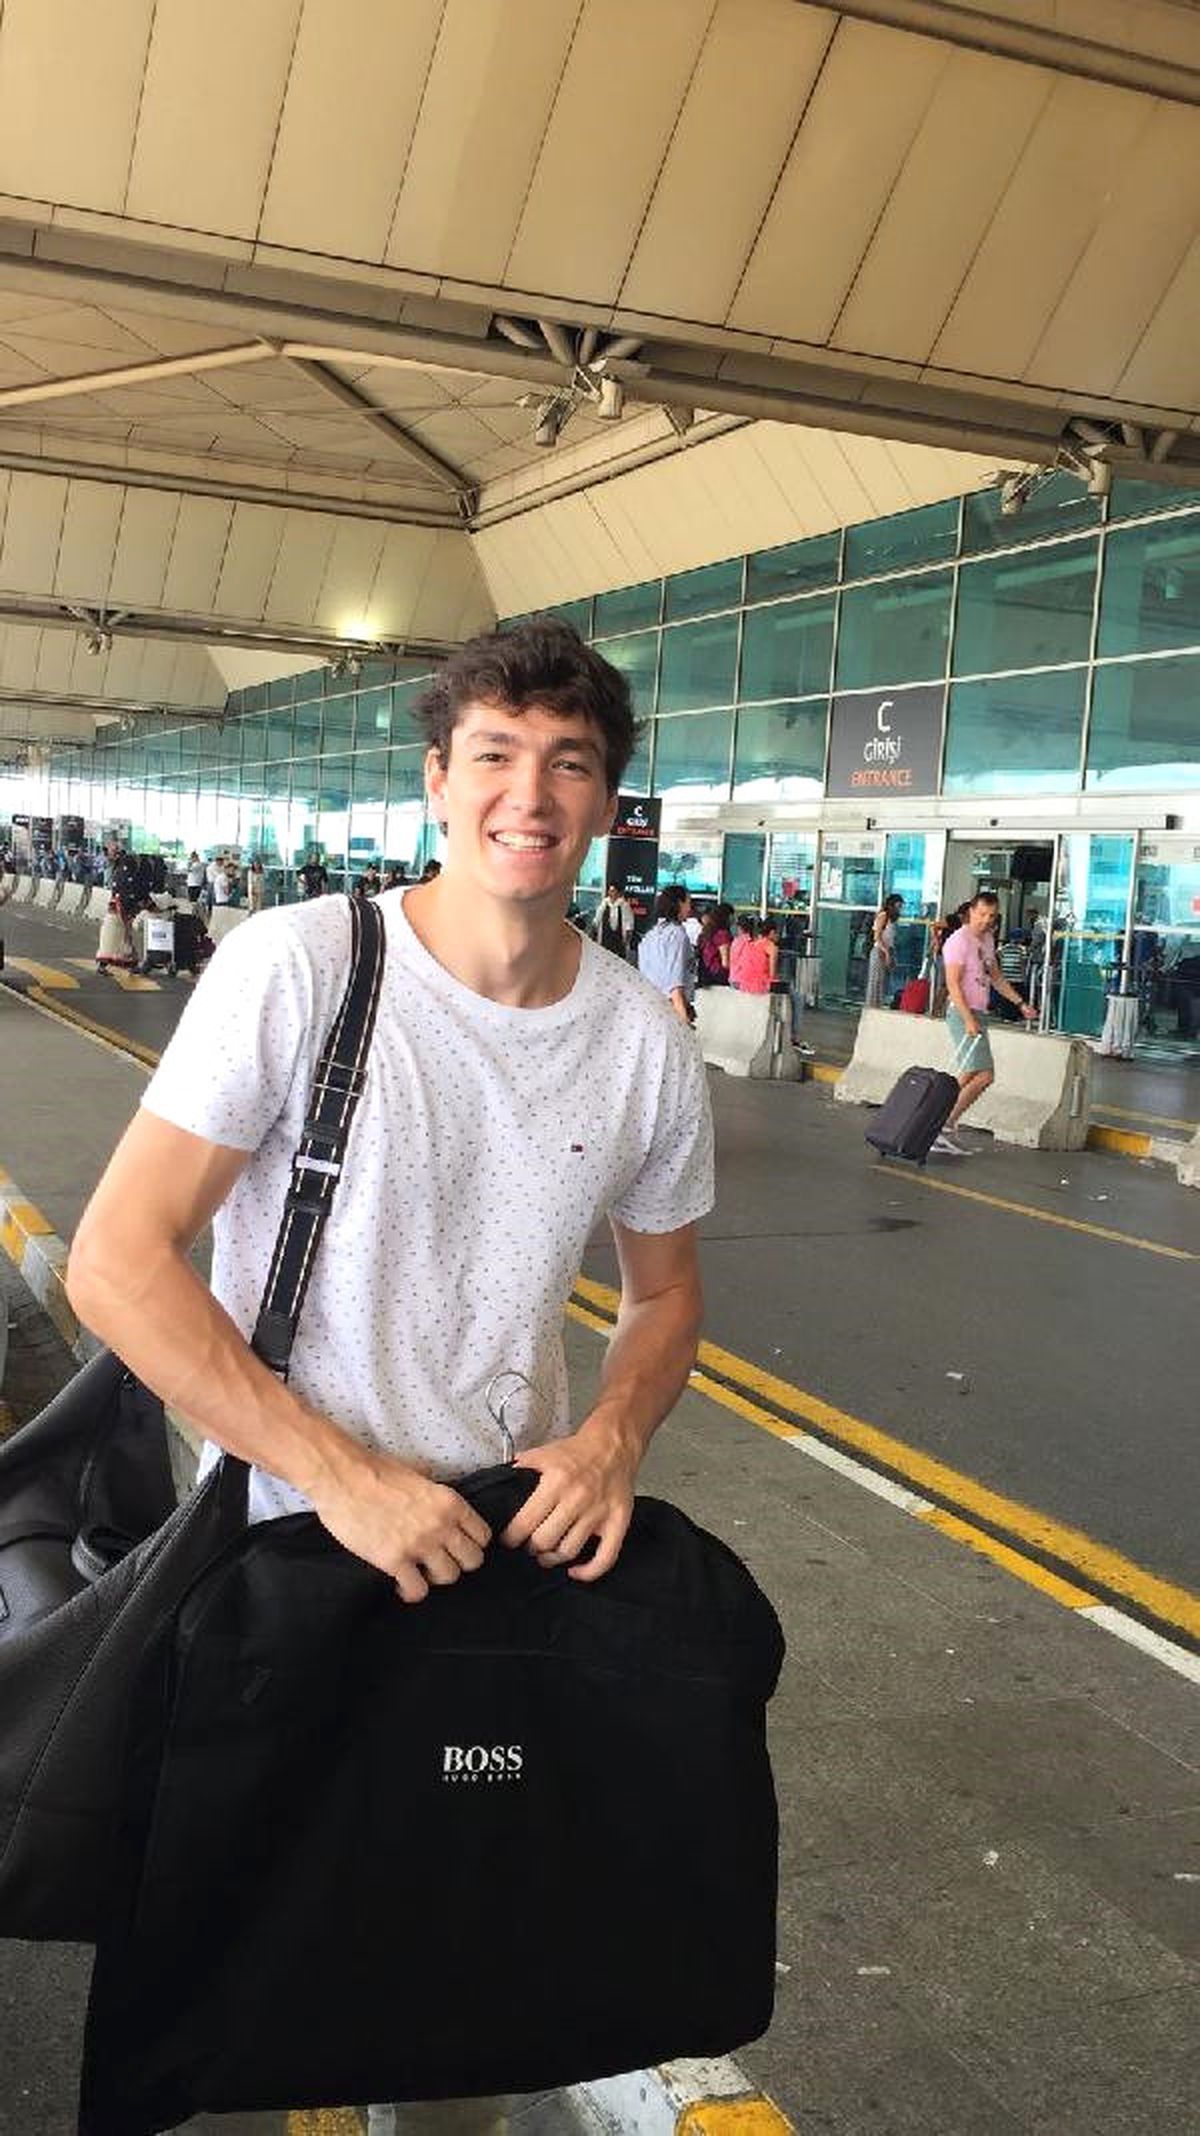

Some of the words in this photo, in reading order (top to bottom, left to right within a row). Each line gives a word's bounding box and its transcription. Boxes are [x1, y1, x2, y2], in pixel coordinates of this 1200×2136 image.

[878, 701, 894, 733] C
[634, 805, 643, 817] C
[443, 1745, 523, 1772] BOSS
